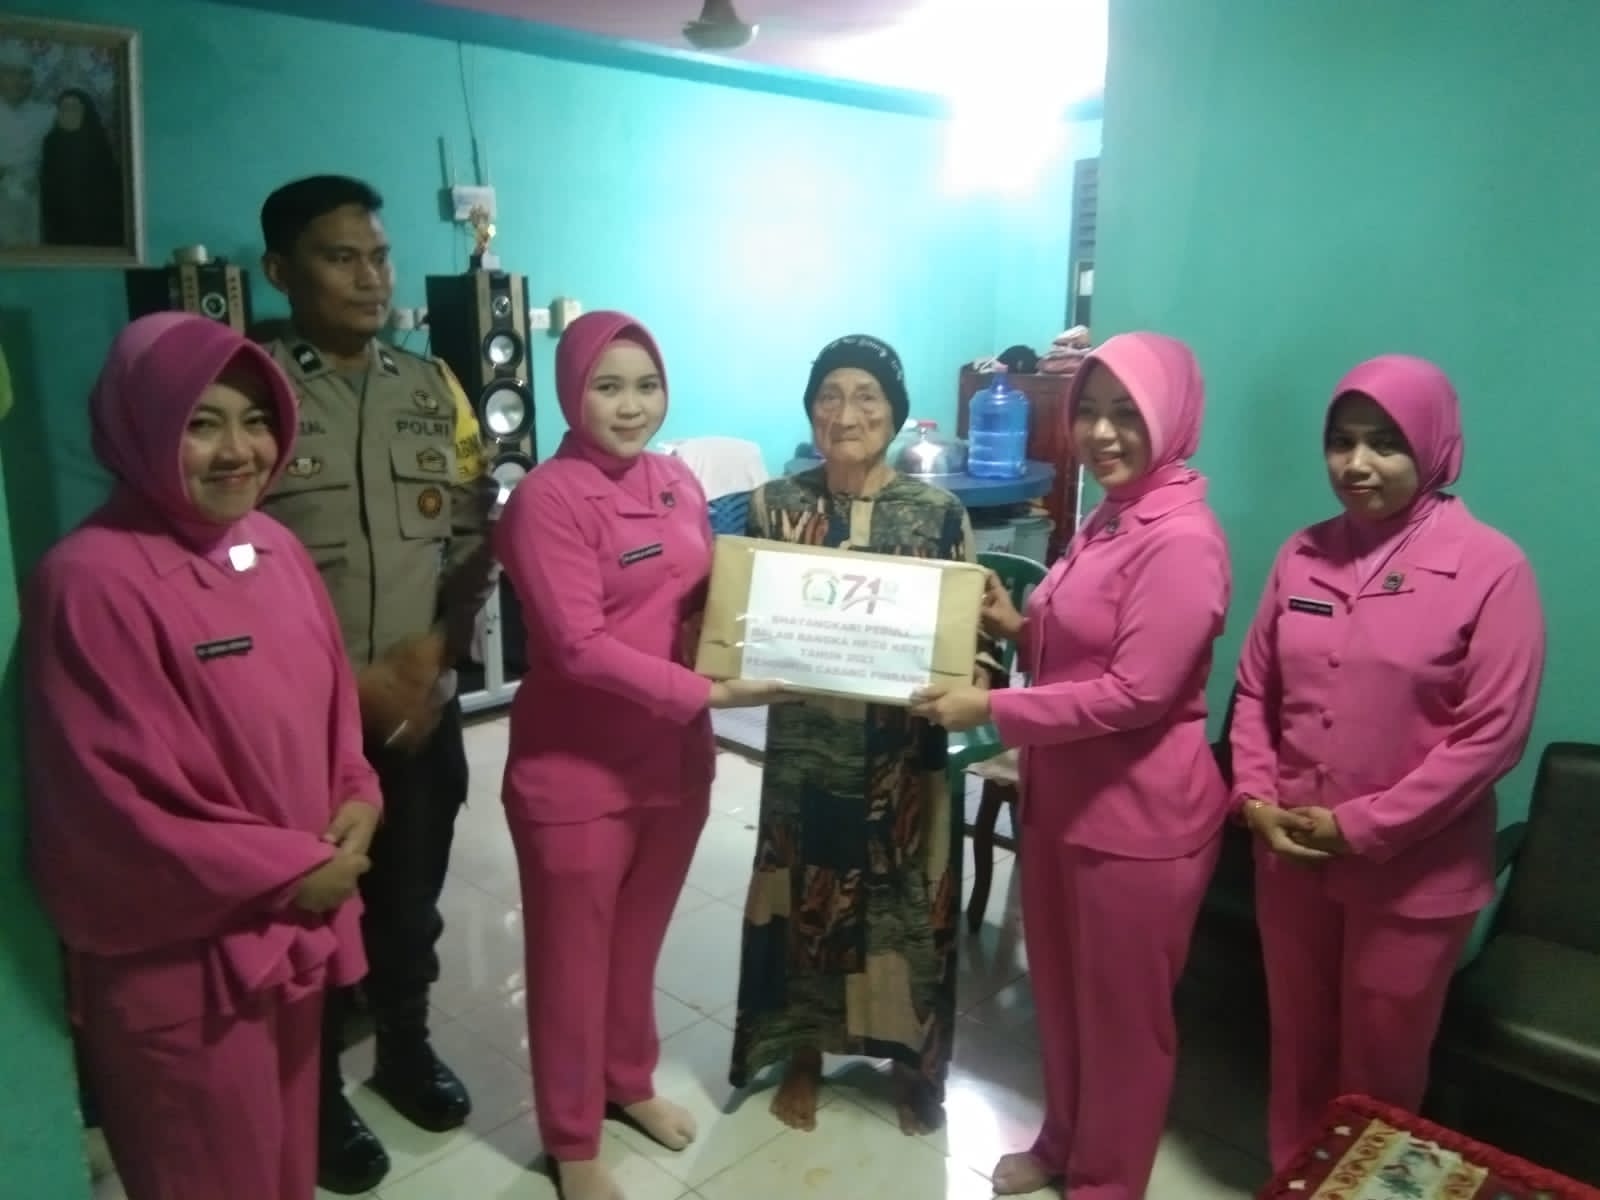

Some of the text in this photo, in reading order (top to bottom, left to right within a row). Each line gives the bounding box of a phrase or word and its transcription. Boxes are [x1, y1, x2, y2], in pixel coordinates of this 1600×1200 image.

[396, 420, 449, 436] POLRI
[841, 573, 882, 615] 71
[800, 647, 843, 660] TAHUN
